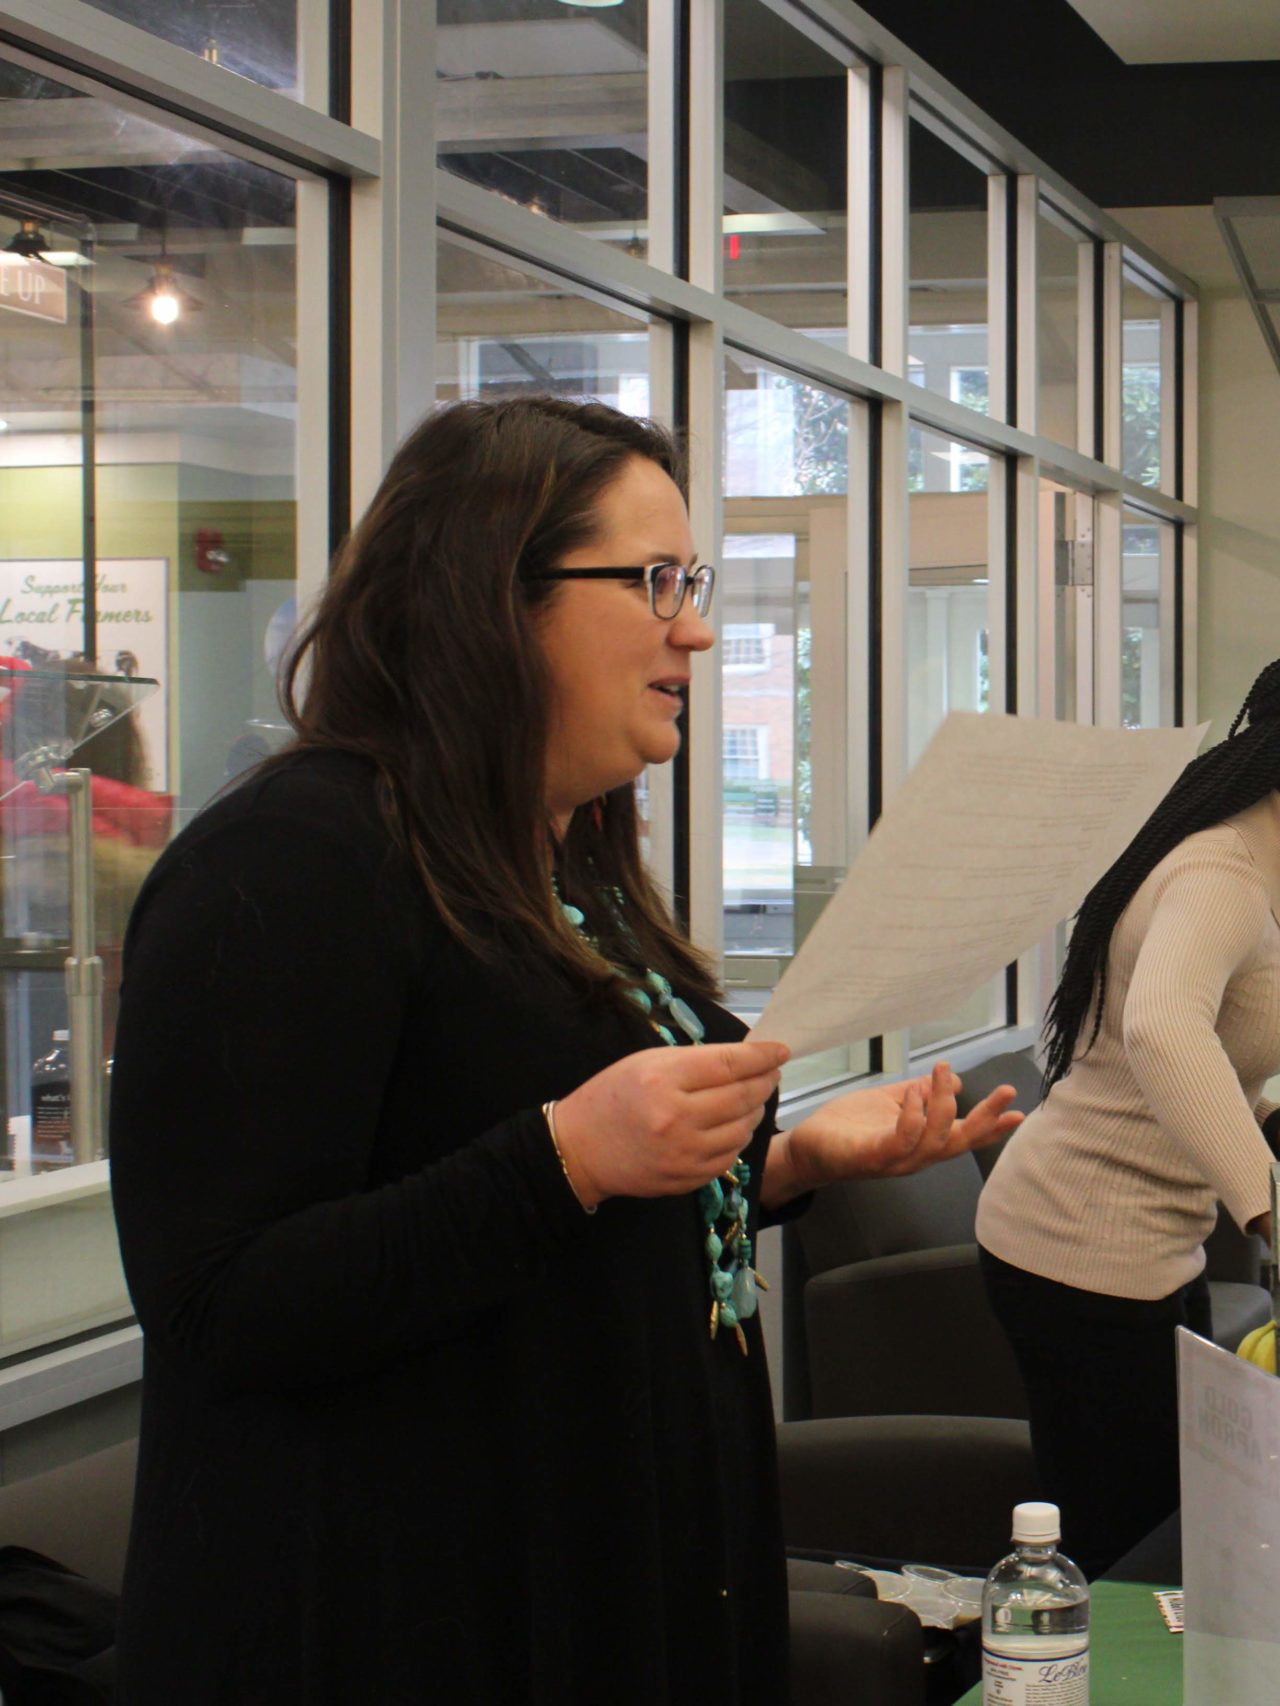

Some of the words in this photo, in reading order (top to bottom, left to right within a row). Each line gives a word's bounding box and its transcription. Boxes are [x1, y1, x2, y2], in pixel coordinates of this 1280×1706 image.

[17, 269, 46, 305] UP
[0, 597, 59, 624] Local
[65, 597, 153, 624] Frmers
